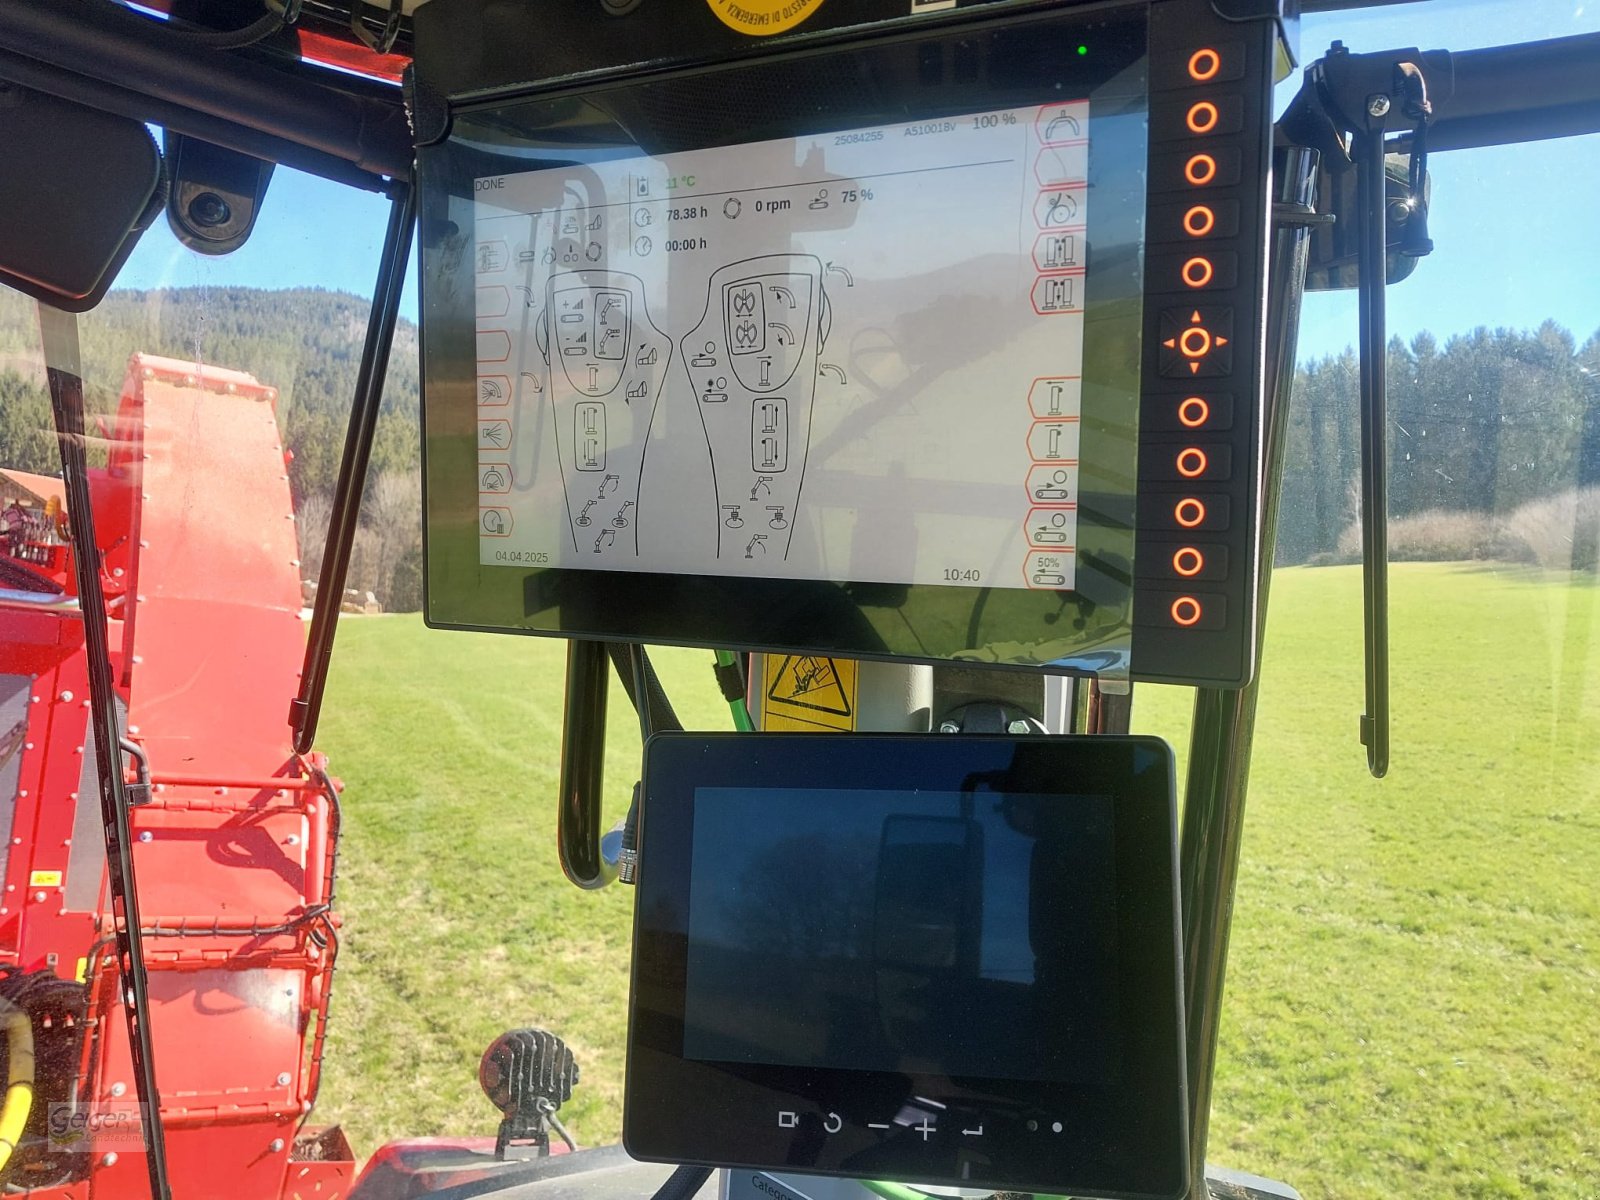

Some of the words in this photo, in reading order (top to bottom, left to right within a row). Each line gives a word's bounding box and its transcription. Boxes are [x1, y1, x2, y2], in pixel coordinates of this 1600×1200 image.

[727, 3, 769, 25] EMERGENZA
[772, 10, 781, 24] DI
[972, 114, 999, 130] 100
[1002, 112, 1017, 126] %
[834, 131, 884, 146] 25084255
[475, 177, 505, 192] DONE
[681, 175, 696, 188] °C
[841, 190, 858, 203] 75
[860, 189, 874, 201] %
[666, 207, 697, 222] 78.38
[700, 205, 708, 218] h
[755, 200, 763, 212] 0
[766, 198, 791, 214] rpm
[665, 238, 696, 252] 00:00
[699, 237, 707, 250] h
[495, 550, 549, 563] 04.04.2025
[1037, 557, 1060, 568] 50%
[943, 568, 981, 582] 10:40
